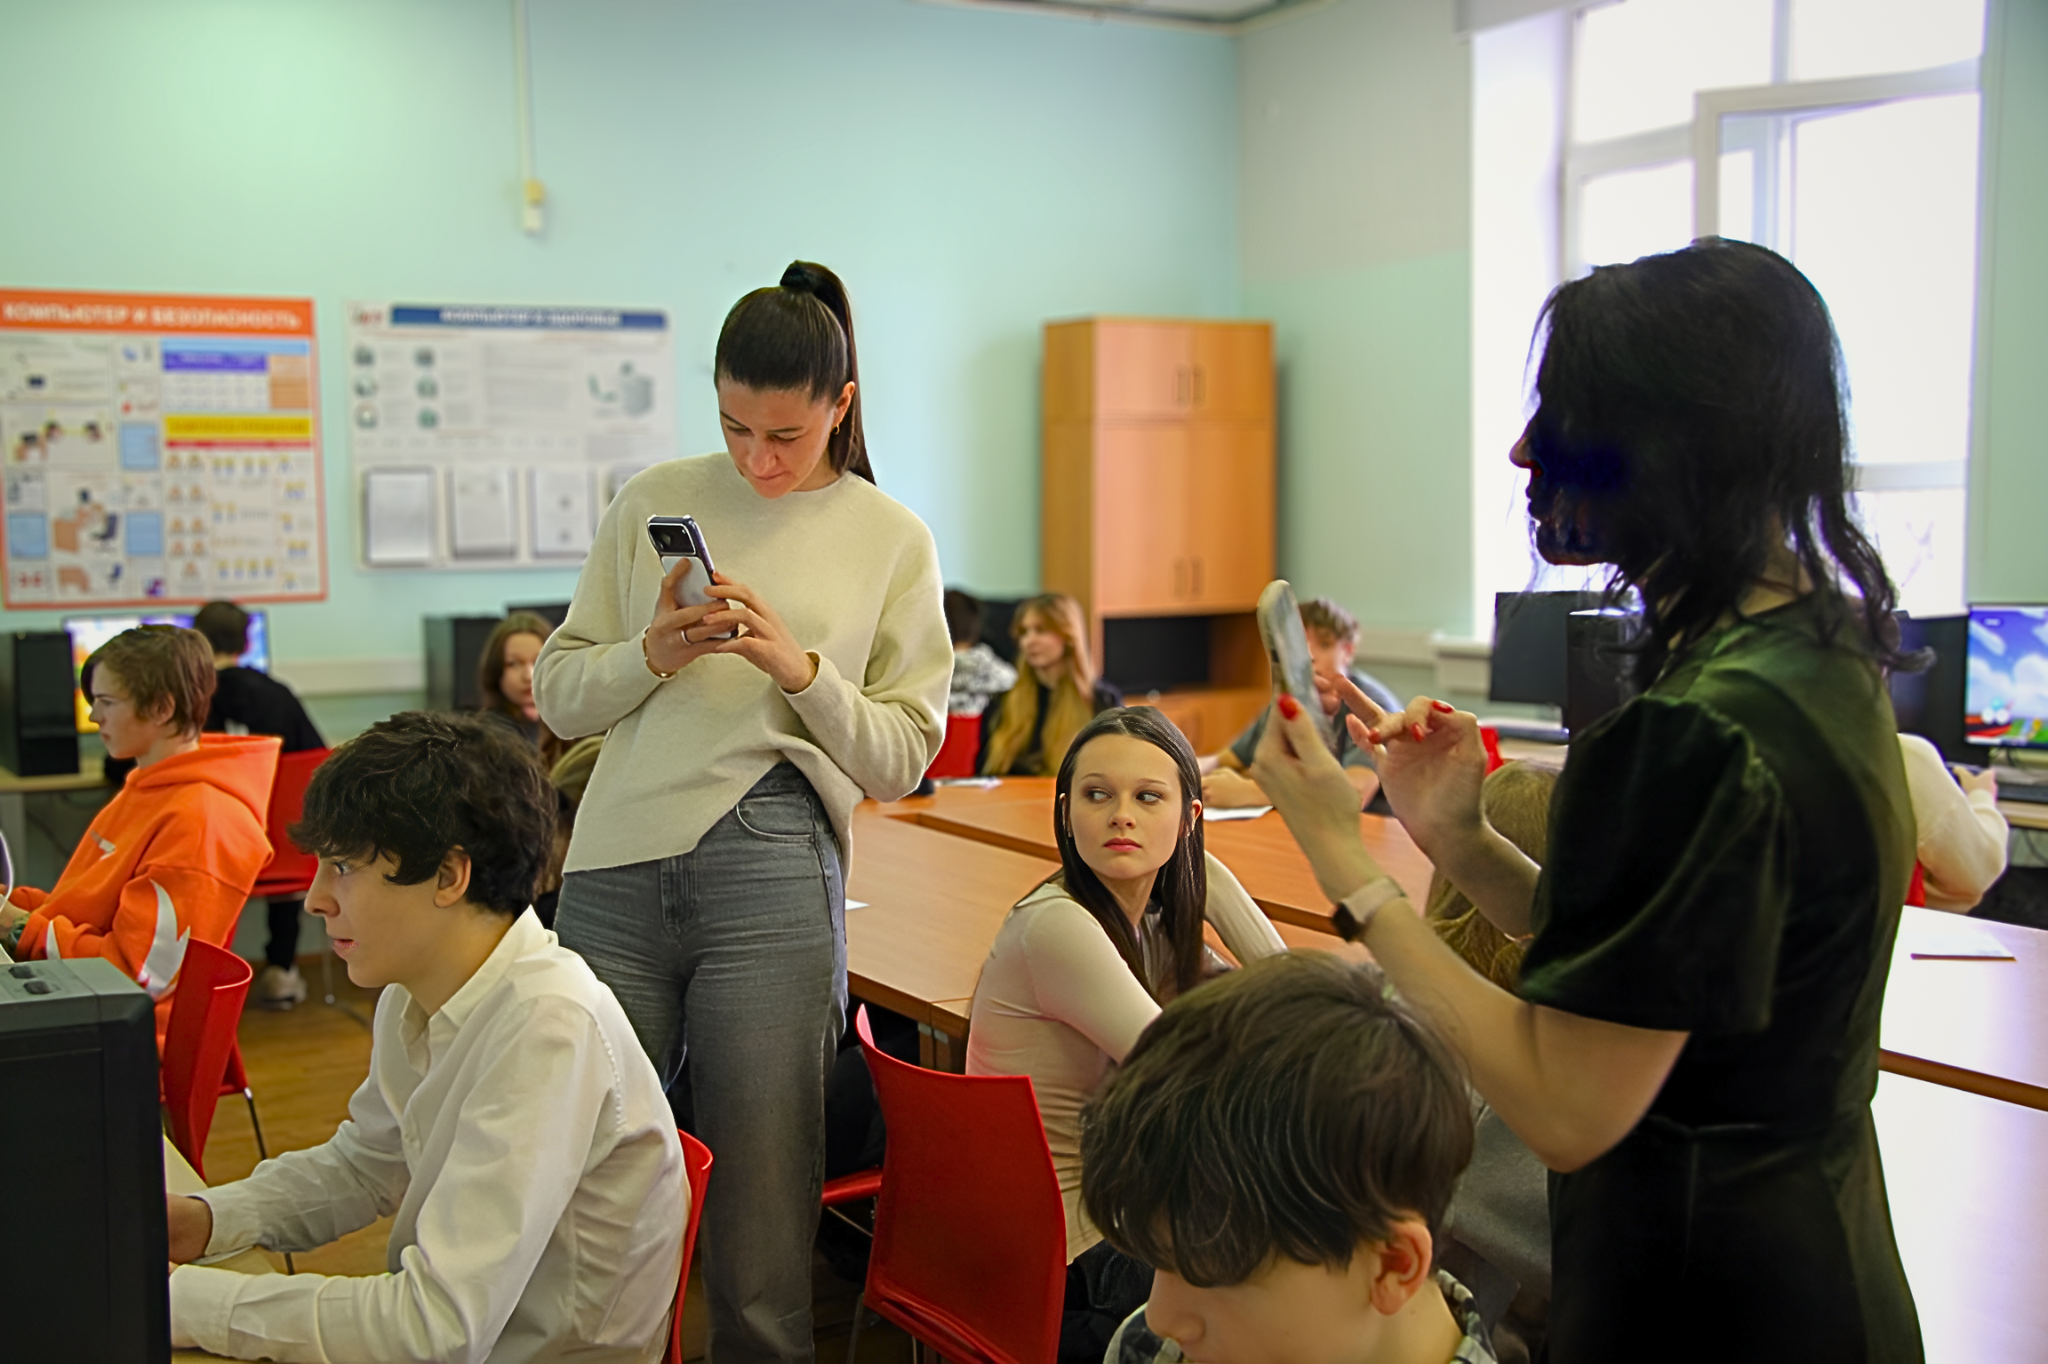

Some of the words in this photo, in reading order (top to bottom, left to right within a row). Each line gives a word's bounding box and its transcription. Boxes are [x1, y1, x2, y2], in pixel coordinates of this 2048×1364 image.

[3, 301, 130, 325] КОМПЬЮТЕР
[131, 305, 148, 326] И
[150, 304, 301, 329] БЕЗОПАСНОСТЬ
